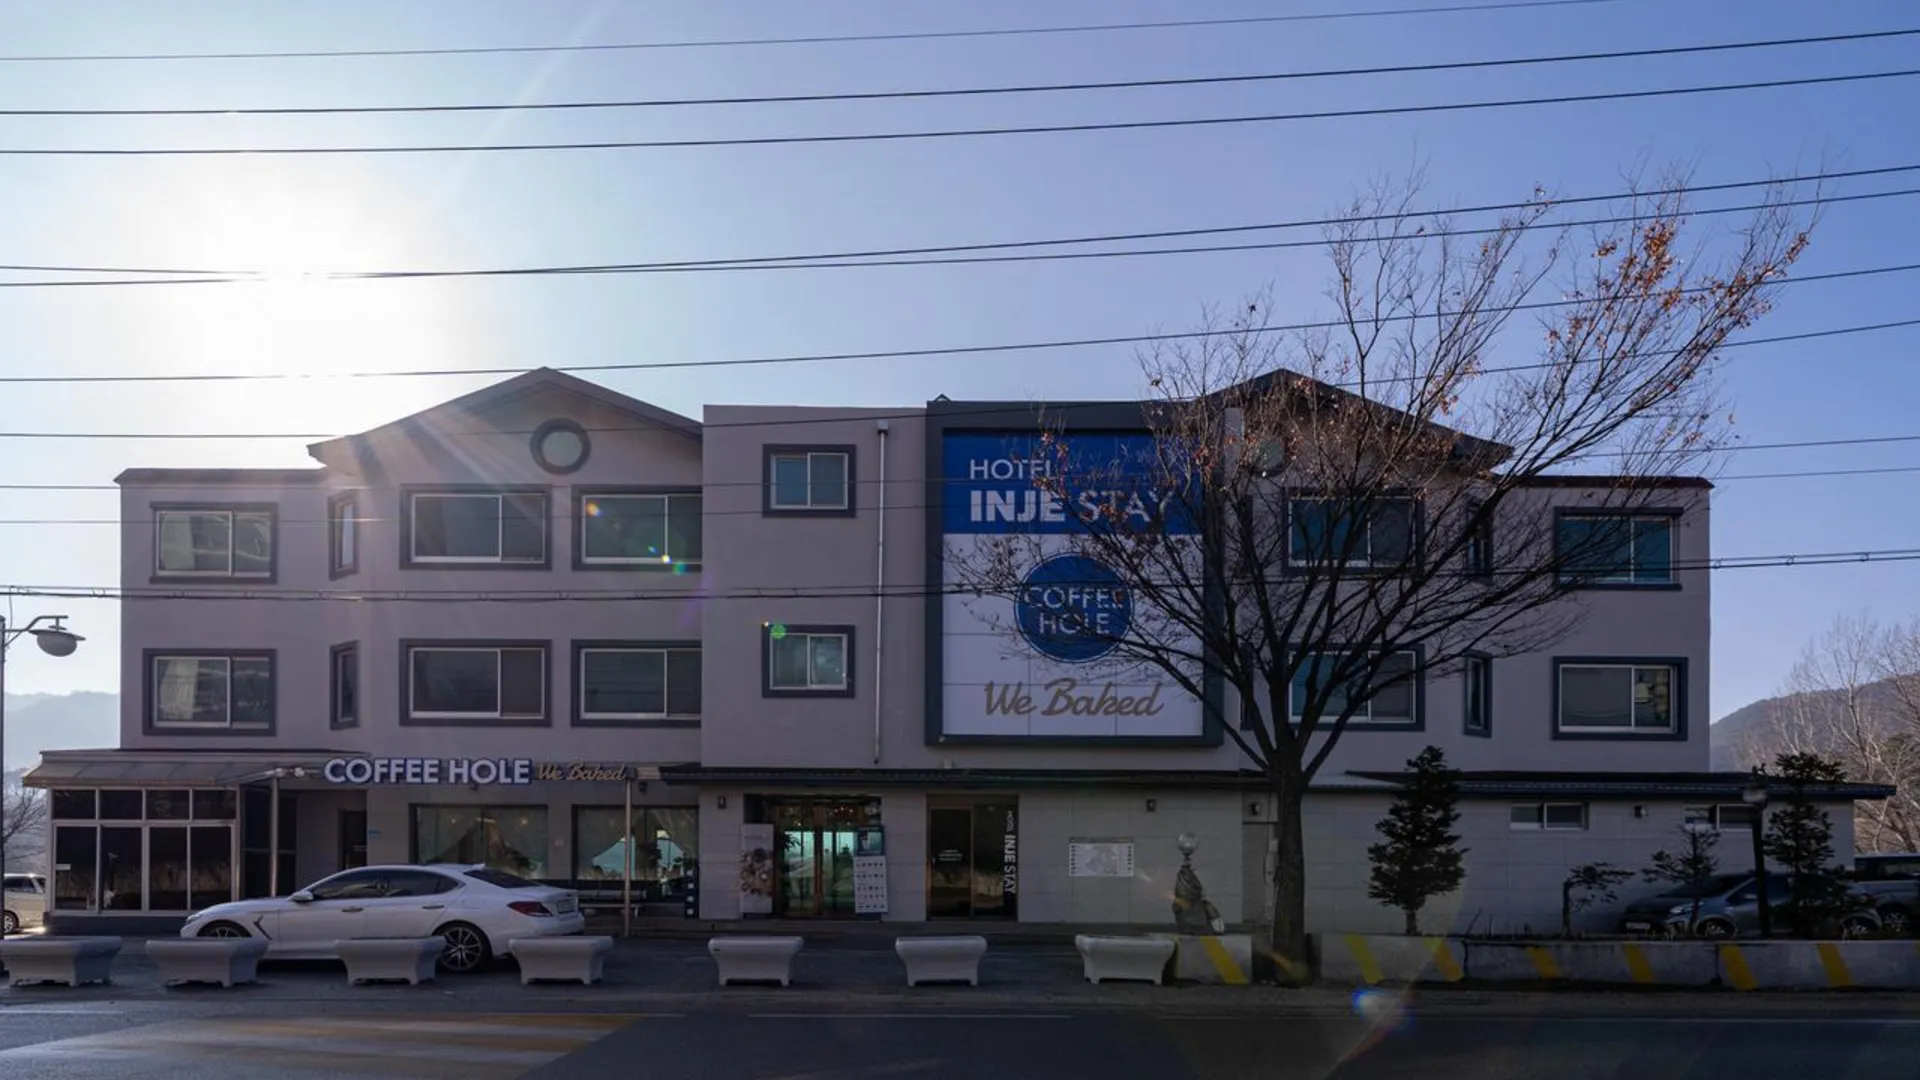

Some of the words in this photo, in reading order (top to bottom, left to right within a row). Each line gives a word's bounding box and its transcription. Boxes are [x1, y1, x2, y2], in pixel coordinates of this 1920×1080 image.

[969, 459, 1055, 480] HOTEL
[969, 490, 1065, 523] INJE
[1079, 489, 1175, 523] STAY
[1023, 587, 1124, 609] COFFEE
[984, 681, 1038, 716] We
[1041, 678, 1165, 716] Baked
[324, 758, 439, 784] COFFEE
[448, 758, 532, 784] HOLE
[536, 763, 562, 780] We
[564, 761, 627, 781] Baked
[1004, 834, 1017, 863] INJE
[1004, 865, 1017, 894] STAY
